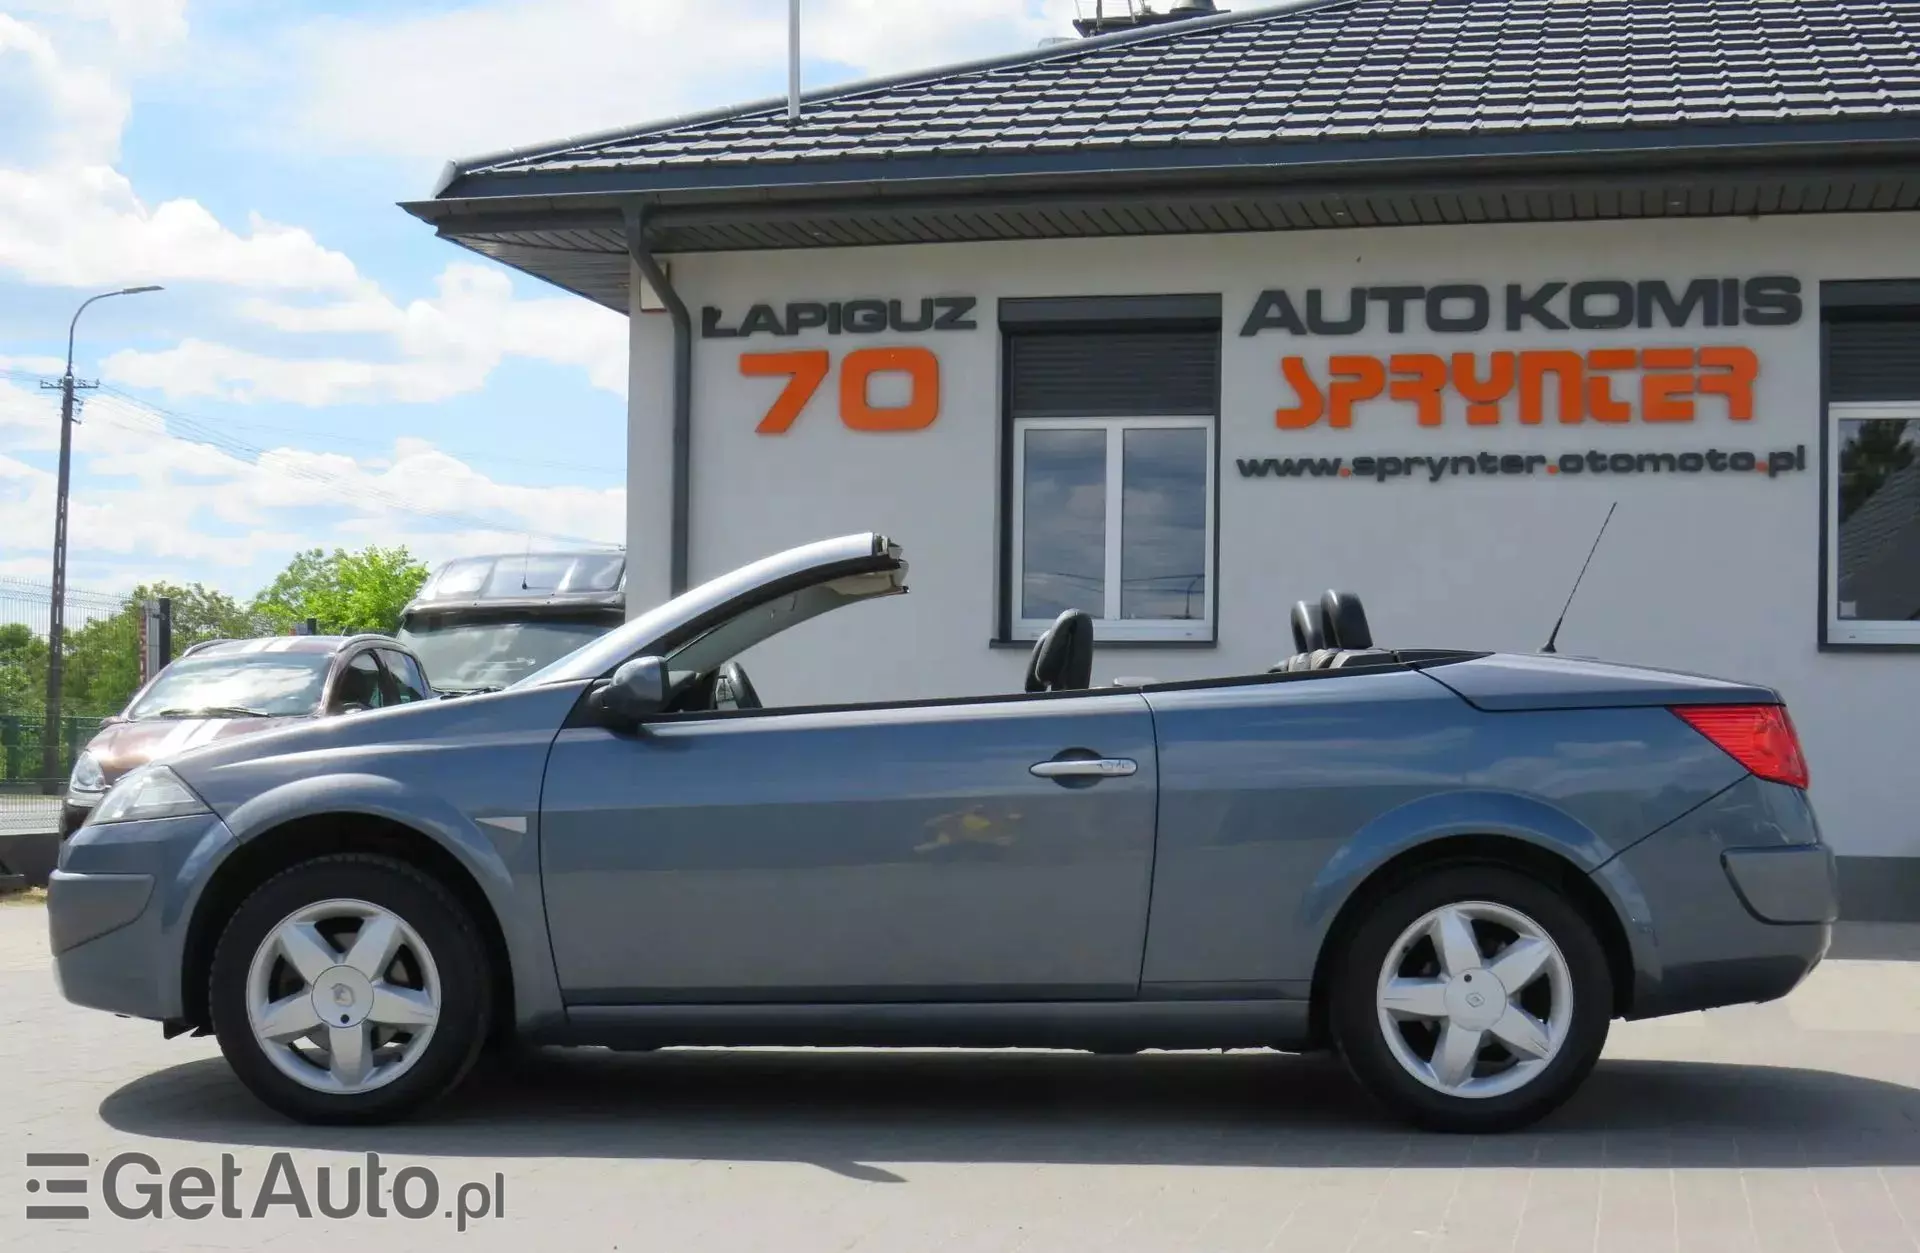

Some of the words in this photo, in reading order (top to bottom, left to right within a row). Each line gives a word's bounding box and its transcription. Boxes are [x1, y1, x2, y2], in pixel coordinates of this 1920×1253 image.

[701, 296, 978, 338] ŁAPIGUZ
[1239, 284, 1491, 336] AUTO
[1506, 275, 1803, 331] KOMIS
[739, 346, 940, 434] 70
[1275, 346, 1760, 430] SPRYNTER
[1237, 445, 1807, 482] www.sprynter.otomoto.pl
